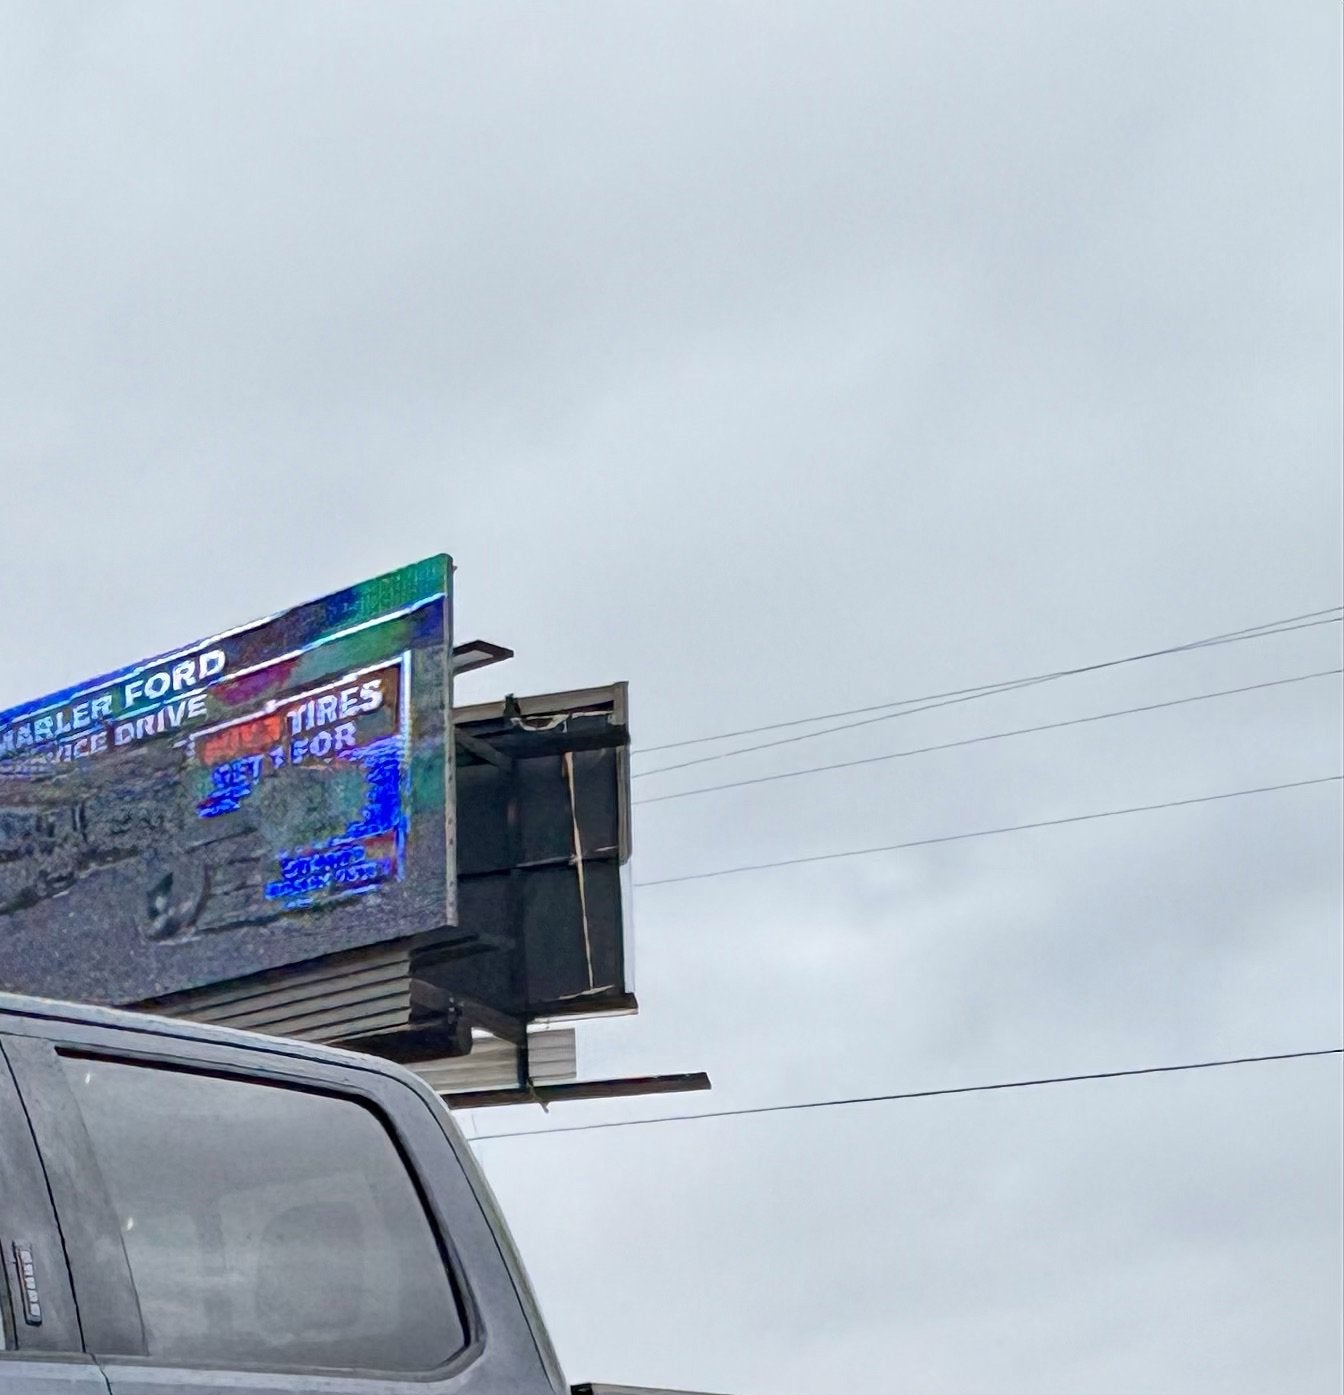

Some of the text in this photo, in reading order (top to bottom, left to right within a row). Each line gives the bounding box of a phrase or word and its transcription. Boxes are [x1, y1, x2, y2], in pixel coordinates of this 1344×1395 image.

[123, 648, 226, 708] FORD
[114, 693, 208, 746] DRIVE
[287, 679, 383, 735] TIRES
[290, 720, 357, 765] FOR
